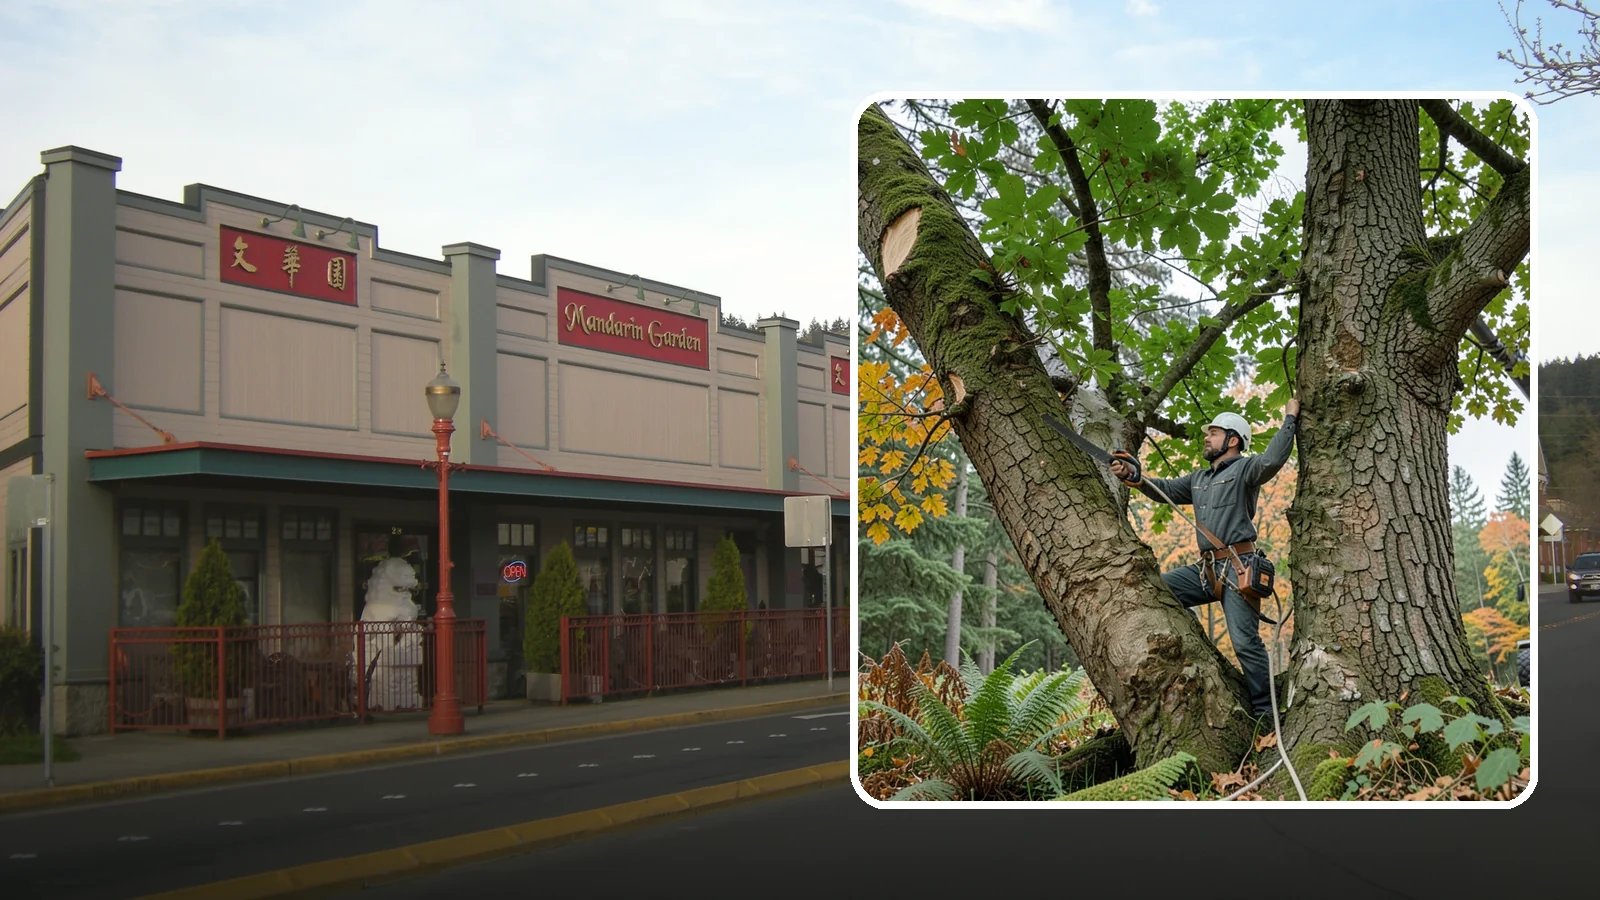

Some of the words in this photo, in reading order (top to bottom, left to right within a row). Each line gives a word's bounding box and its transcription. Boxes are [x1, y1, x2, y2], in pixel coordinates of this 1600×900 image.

[230, 235, 346, 291] 文華園
[564, 302, 644, 341] Mandarin
[647, 320, 702, 352] Garden
[834, 363, 847, 386] 文
[503, 565, 527, 578] OPEN
